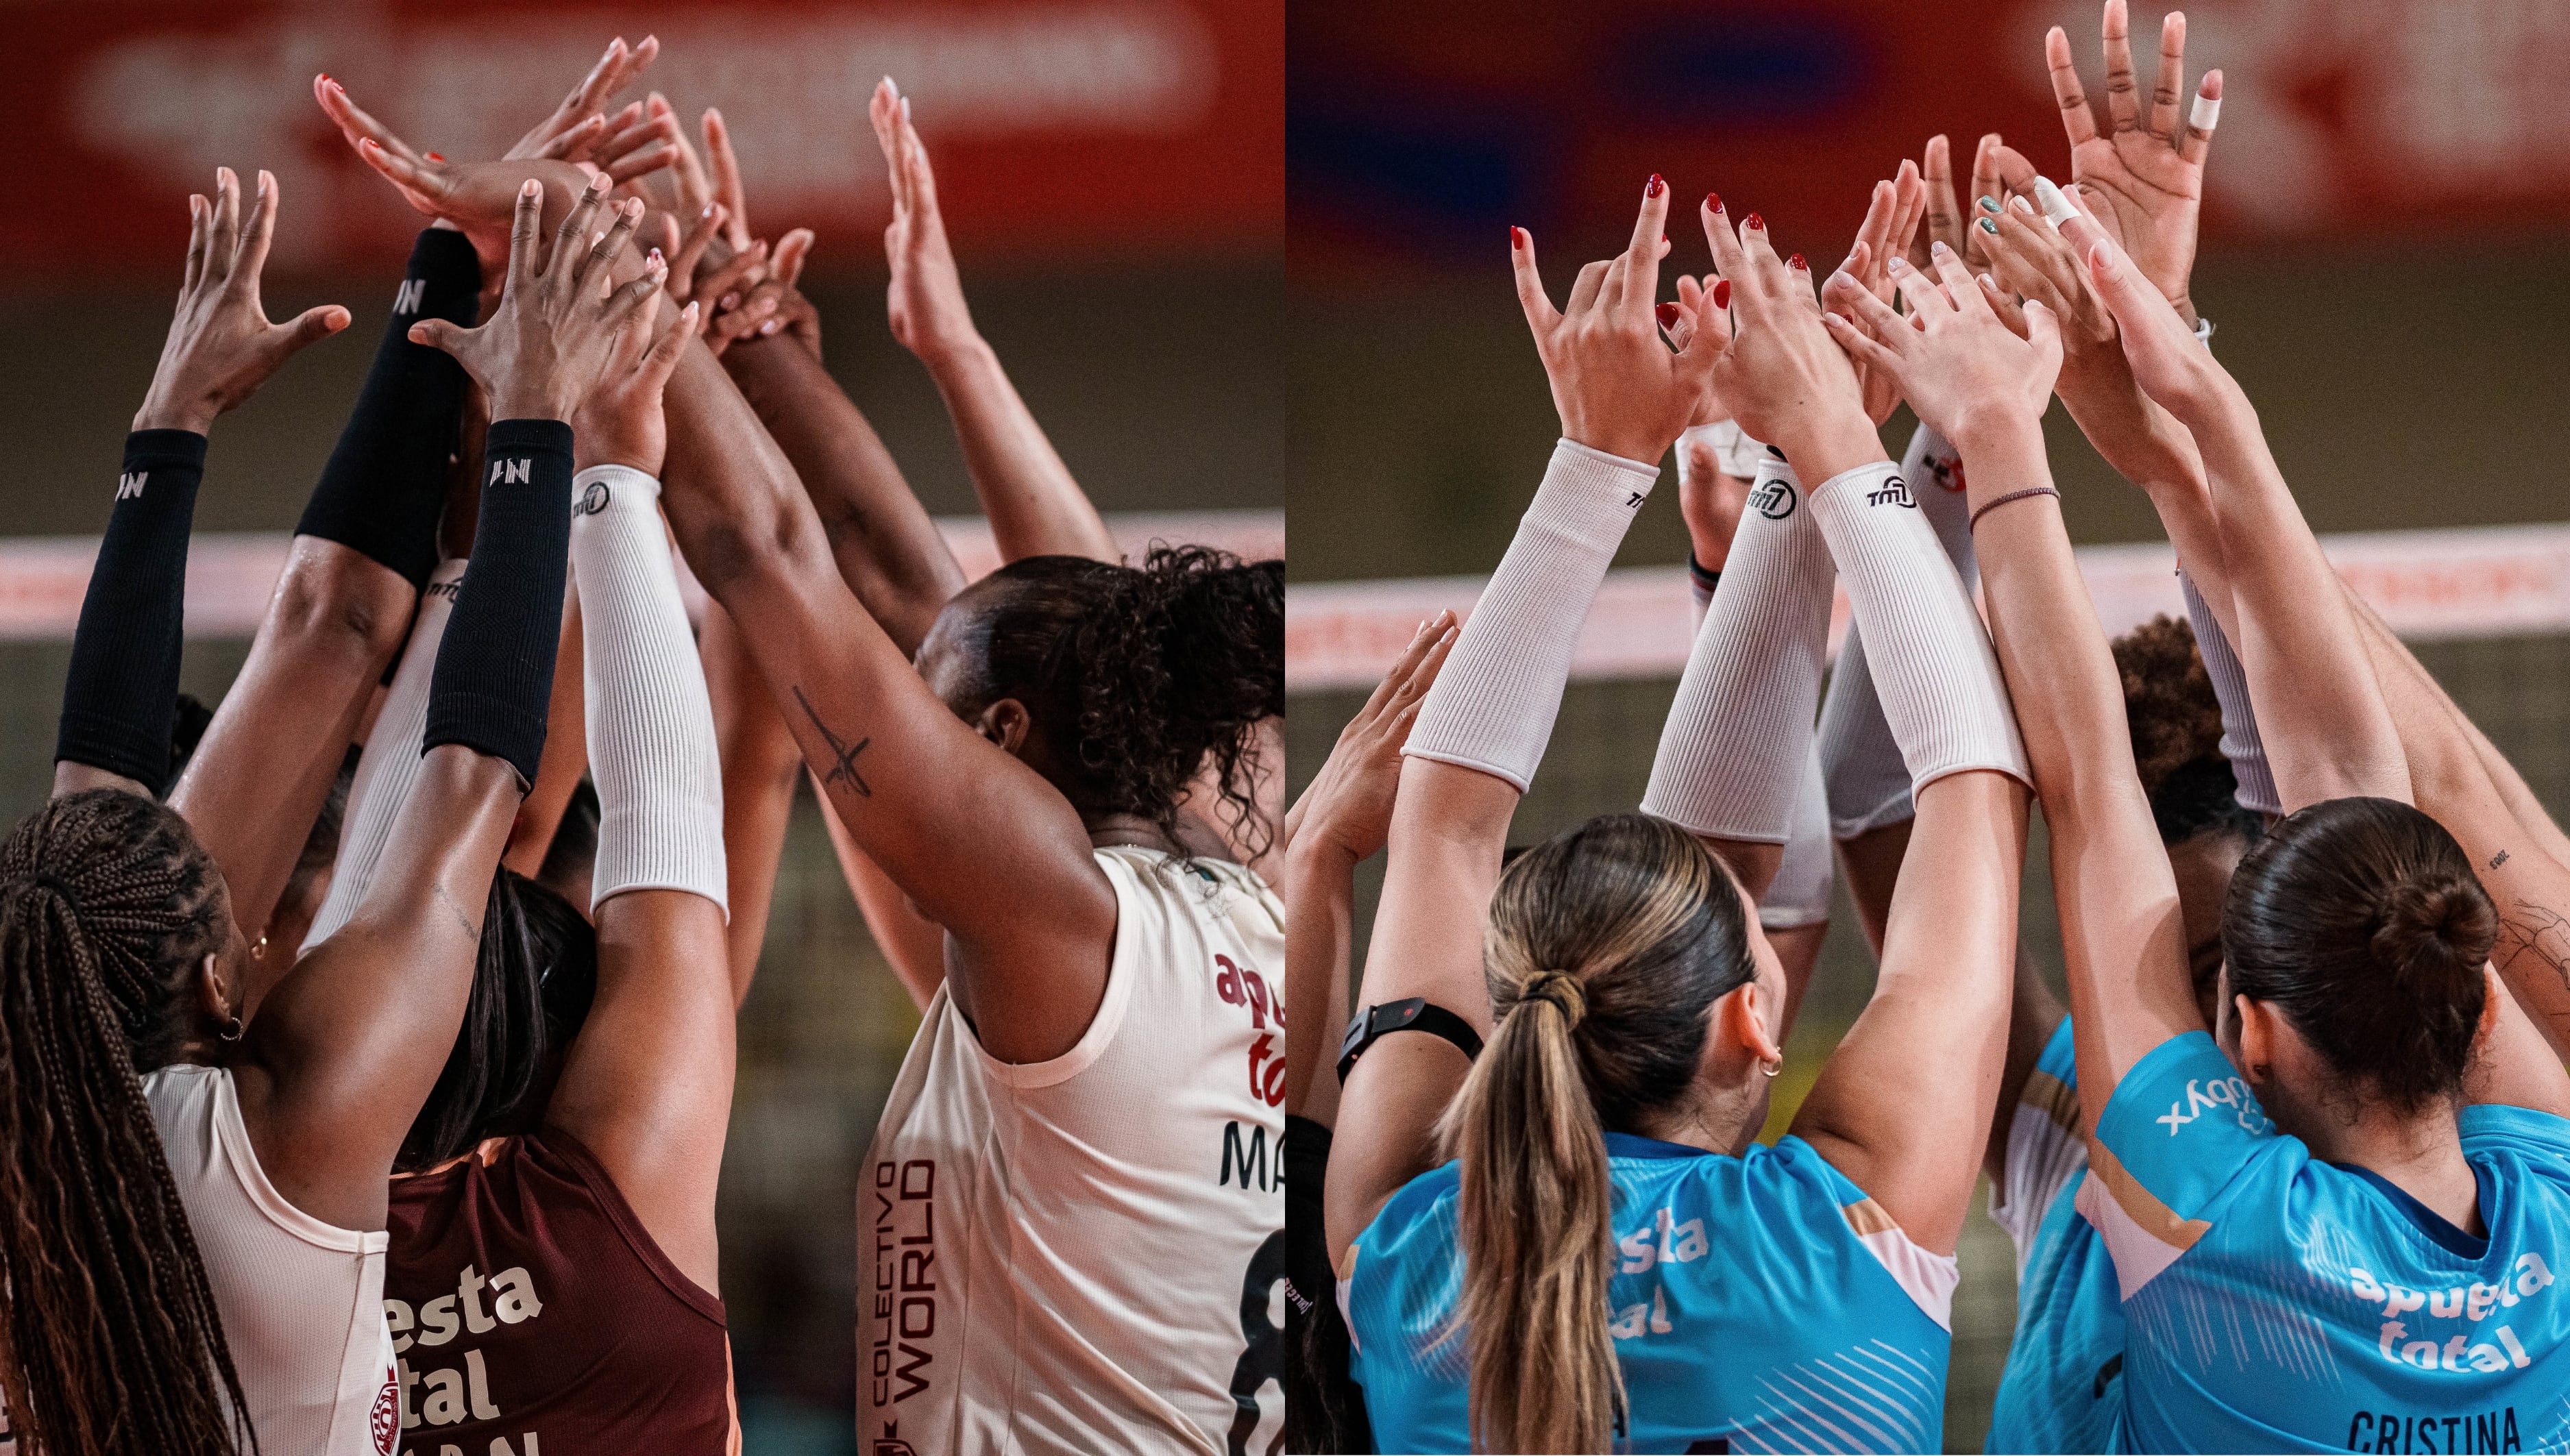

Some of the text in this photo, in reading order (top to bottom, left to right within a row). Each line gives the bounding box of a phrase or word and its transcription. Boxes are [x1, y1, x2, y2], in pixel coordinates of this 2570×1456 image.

[873, 1161, 896, 1408] COLECTIVO
[893, 1159, 935, 1405] WORLD
[1612, 1206, 1709, 1274] sta
[2347, 1406, 2522, 1455] CRISTINA
